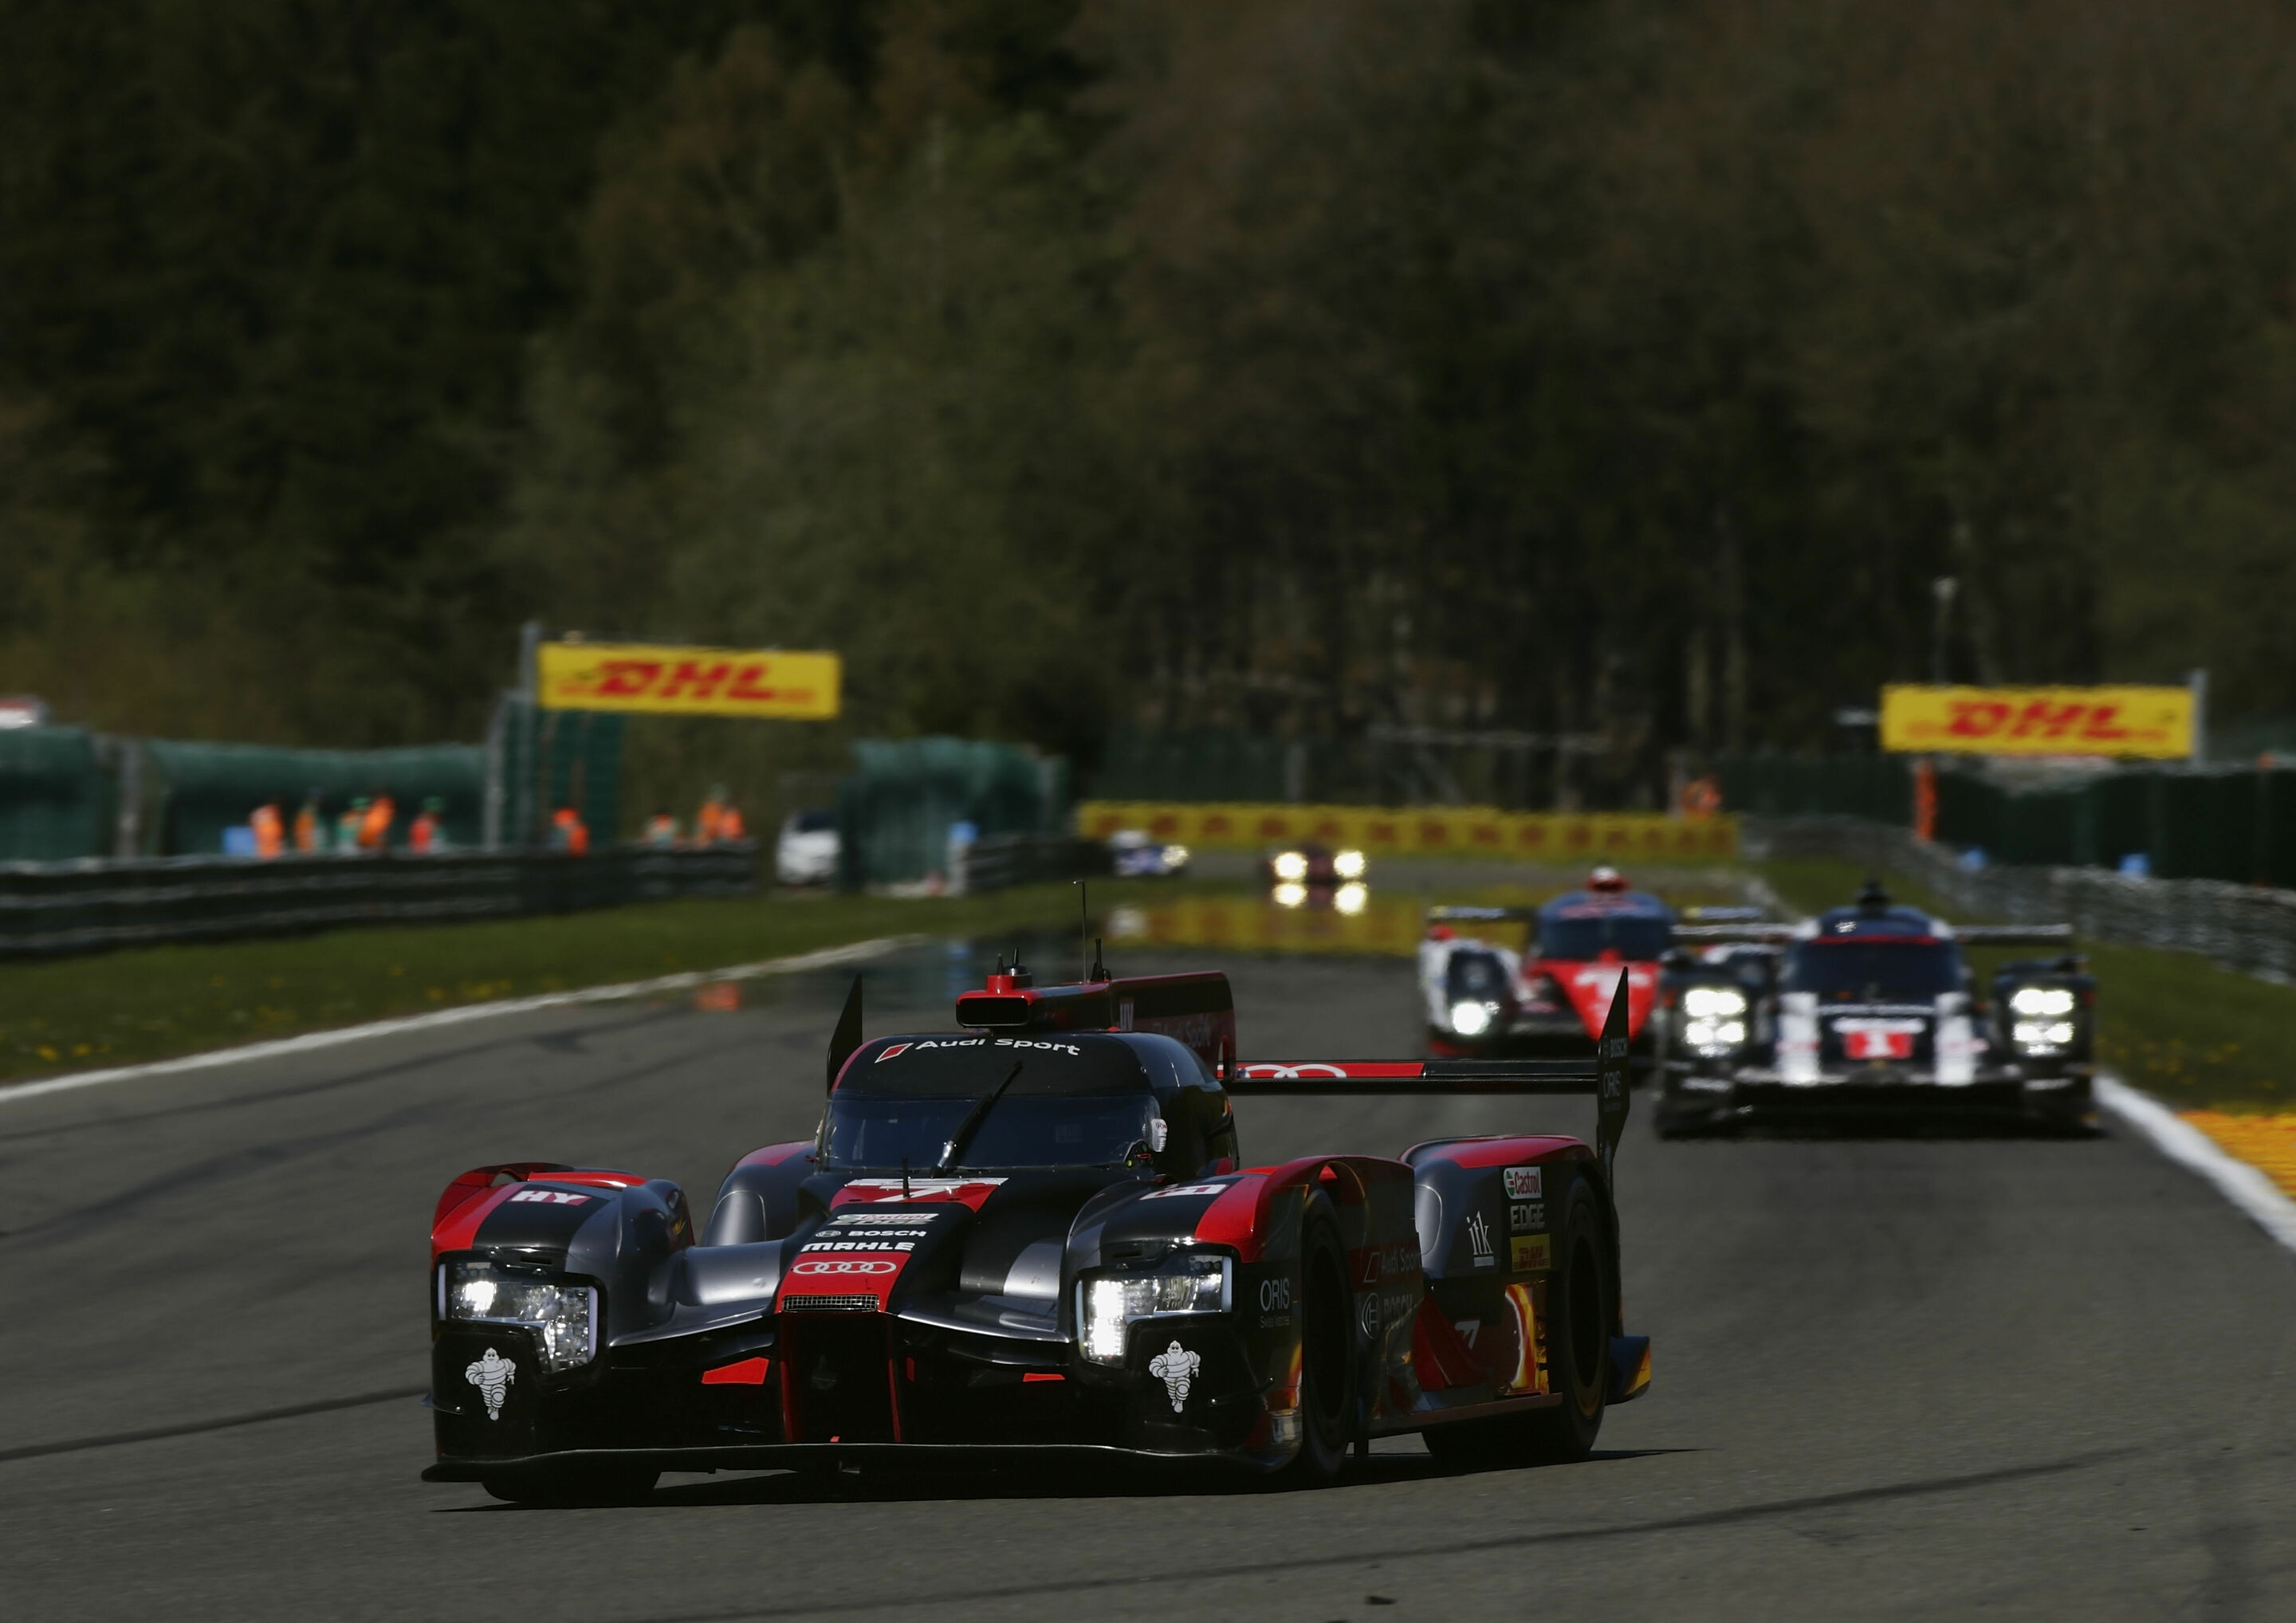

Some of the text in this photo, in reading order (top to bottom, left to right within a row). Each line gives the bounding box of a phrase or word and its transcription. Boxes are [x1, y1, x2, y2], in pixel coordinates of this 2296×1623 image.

[596, 659, 775, 700] DHL
[1947, 700, 2125, 739] DHL
[915, 1039, 1081, 1056] Audi Sport
[844, 1177, 1009, 1202] 7
[1514, 1170, 1541, 1194] Castrol
[510, 1190, 588, 1204] HY
[1510, 1203, 1547, 1231] EDGE
[1466, 1209, 1493, 1256] itk
[800, 1242, 916, 1252] MAHLE
[1260, 1278, 1290, 1311] ORIS
